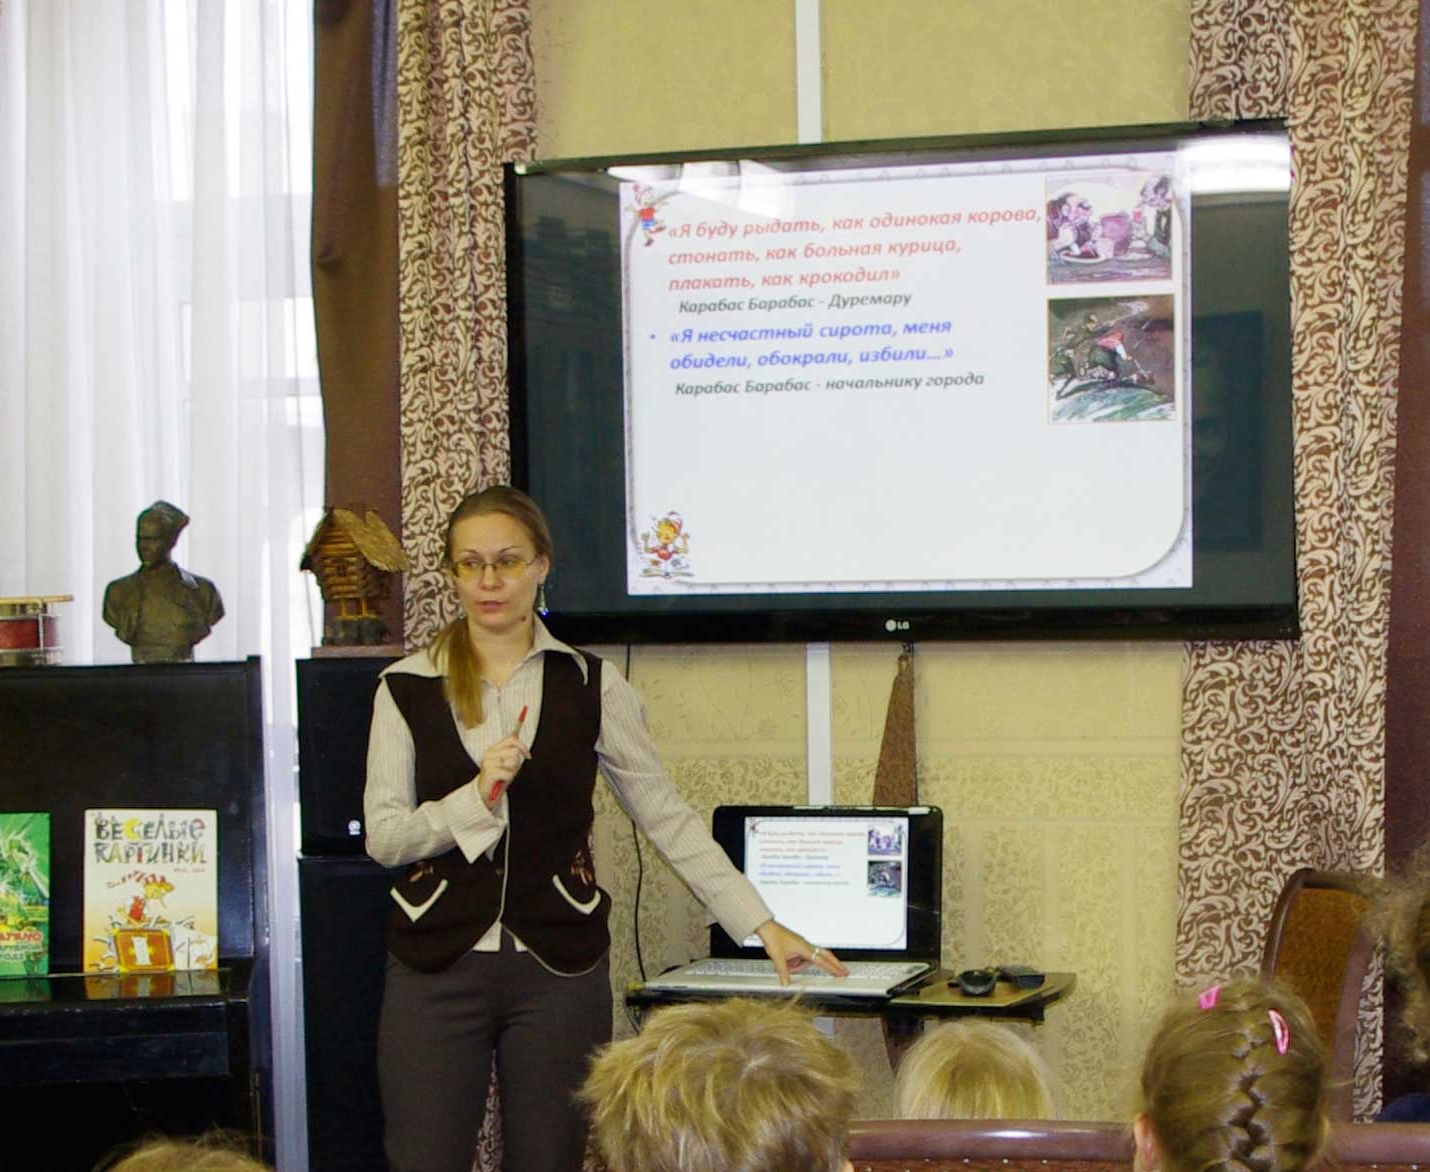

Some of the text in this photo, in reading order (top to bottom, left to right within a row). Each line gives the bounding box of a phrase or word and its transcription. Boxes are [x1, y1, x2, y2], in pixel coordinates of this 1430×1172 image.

[696, 220, 737, 240] буду
[743, 217, 826, 238] рыдать,
[832, 217, 864, 230] как
[869, 211, 961, 229] одинокая
[967, 208, 1041, 226] корова,
[668, 239, 961, 265] стонать, как больная курица,
[668, 266, 900, 291] плакать, как крокодил»
[679, 297, 744, 315] Карабас
[748, 296, 815, 313] Барабас
[828, 293, 912, 309] Дуремару
[698, 322, 813, 343] несчастный
[819, 322, 897, 340] сирота,
[902, 320, 952, 335] меня
[669, 352, 752, 370] обидели,
[757, 349, 854, 367] обокрали,
[675, 379, 741, 397] Карабас
[744, 378, 811, 395] Барабас
[825, 375, 923, 391] начальнику
[925, 371, 984, 389] города
